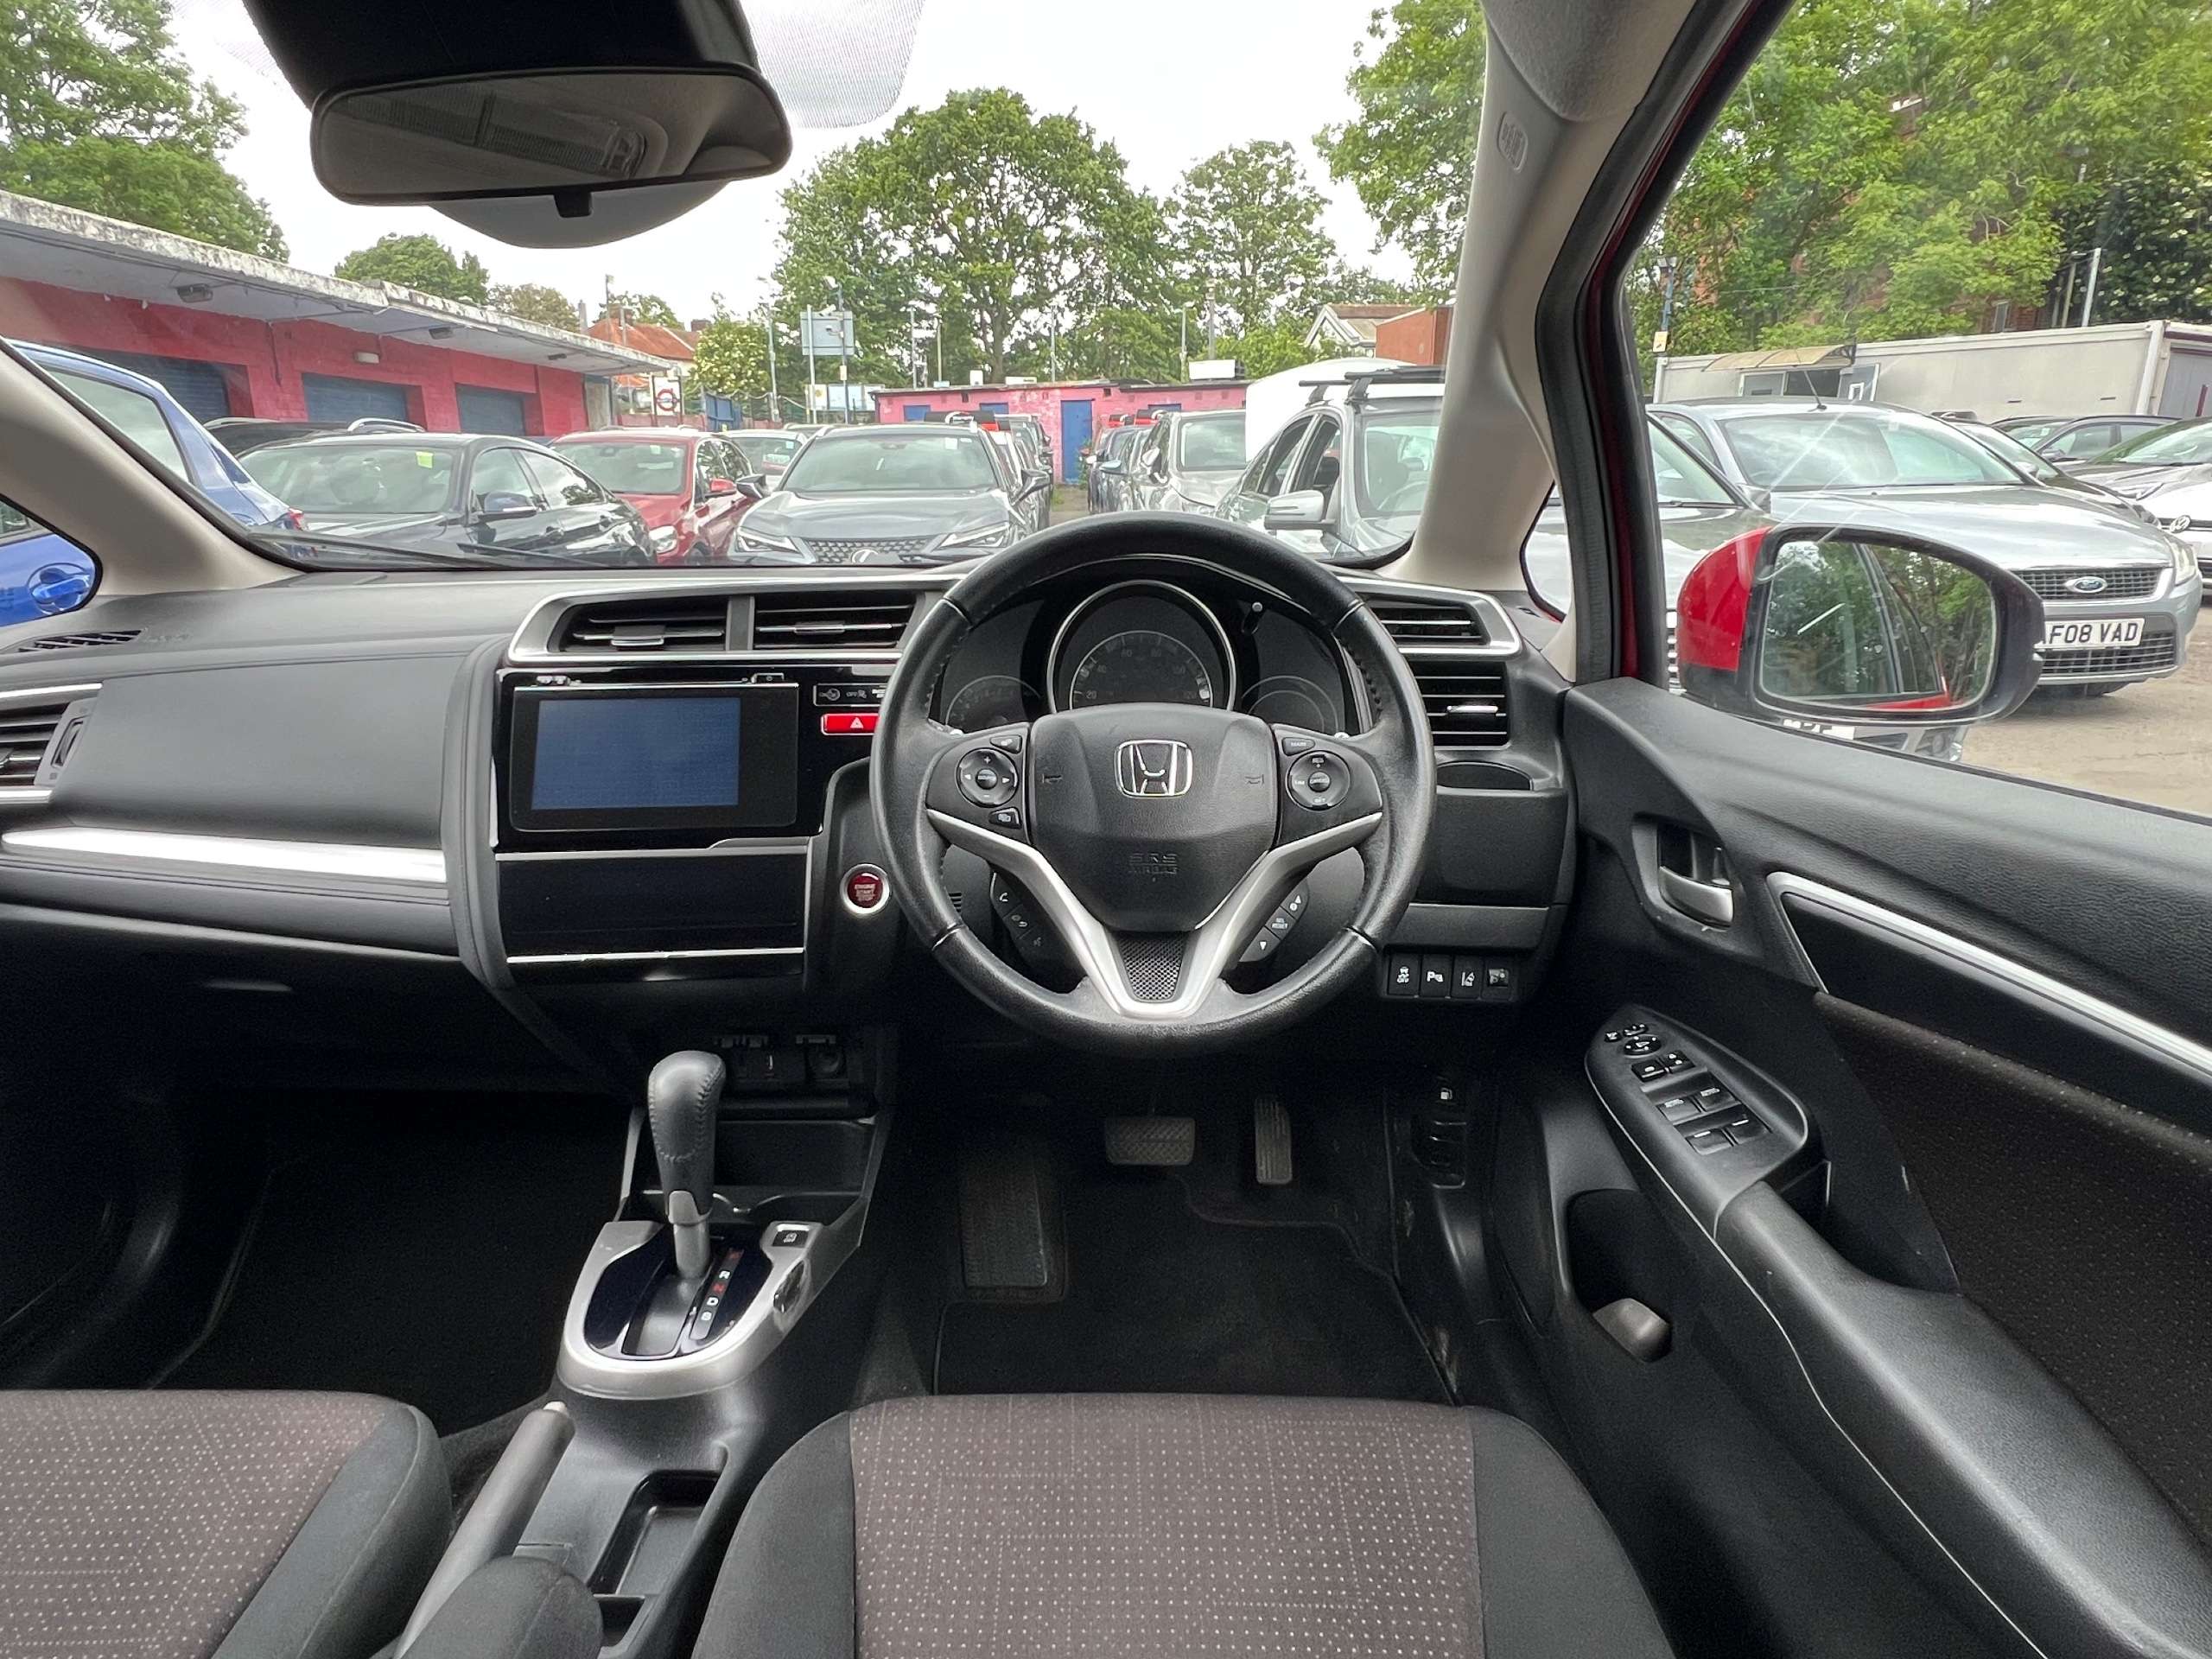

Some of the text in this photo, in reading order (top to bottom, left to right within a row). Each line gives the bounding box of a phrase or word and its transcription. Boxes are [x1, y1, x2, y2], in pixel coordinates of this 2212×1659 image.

[2043, 622, 2139, 645] F08 VAD
[707, 1296, 720, 1306] D
